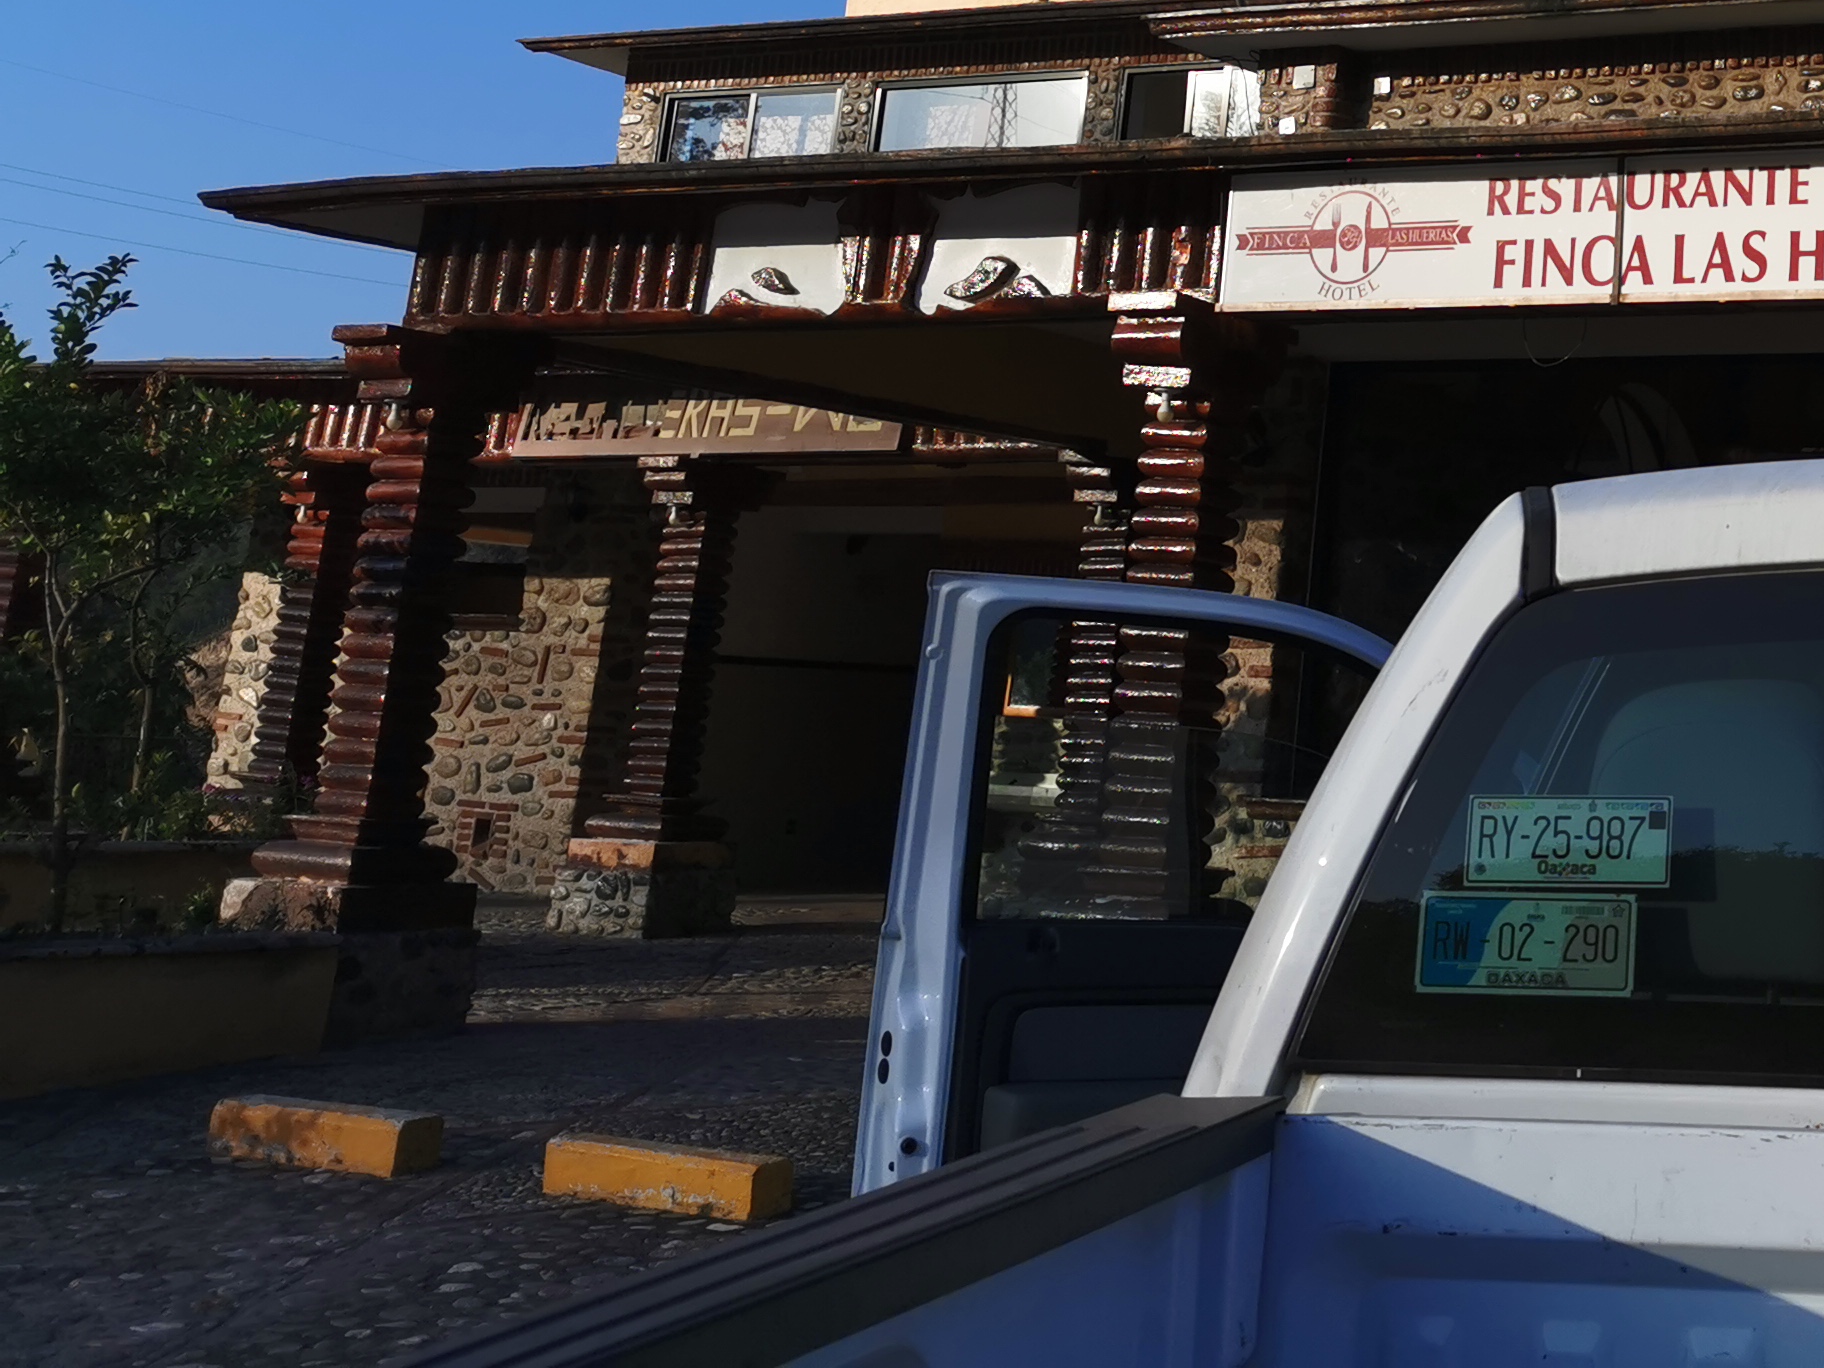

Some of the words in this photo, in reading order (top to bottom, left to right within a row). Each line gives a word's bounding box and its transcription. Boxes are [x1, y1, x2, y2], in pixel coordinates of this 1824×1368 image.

[1486, 165, 1811, 216] RESTAURANTE
[1252, 233, 1311, 249] FINCA
[1387, 229, 1408, 245] LAS
[1408, 227, 1454, 244] HUERTAS
[1493, 234, 1655, 289] FINCA
[1672, 229, 1768, 285] LAS
[1317, 279, 1381, 301] HOTEL
[1477, 814, 1647, 860] RY-25-987
[1486, 971, 1568, 986] OAXACA
